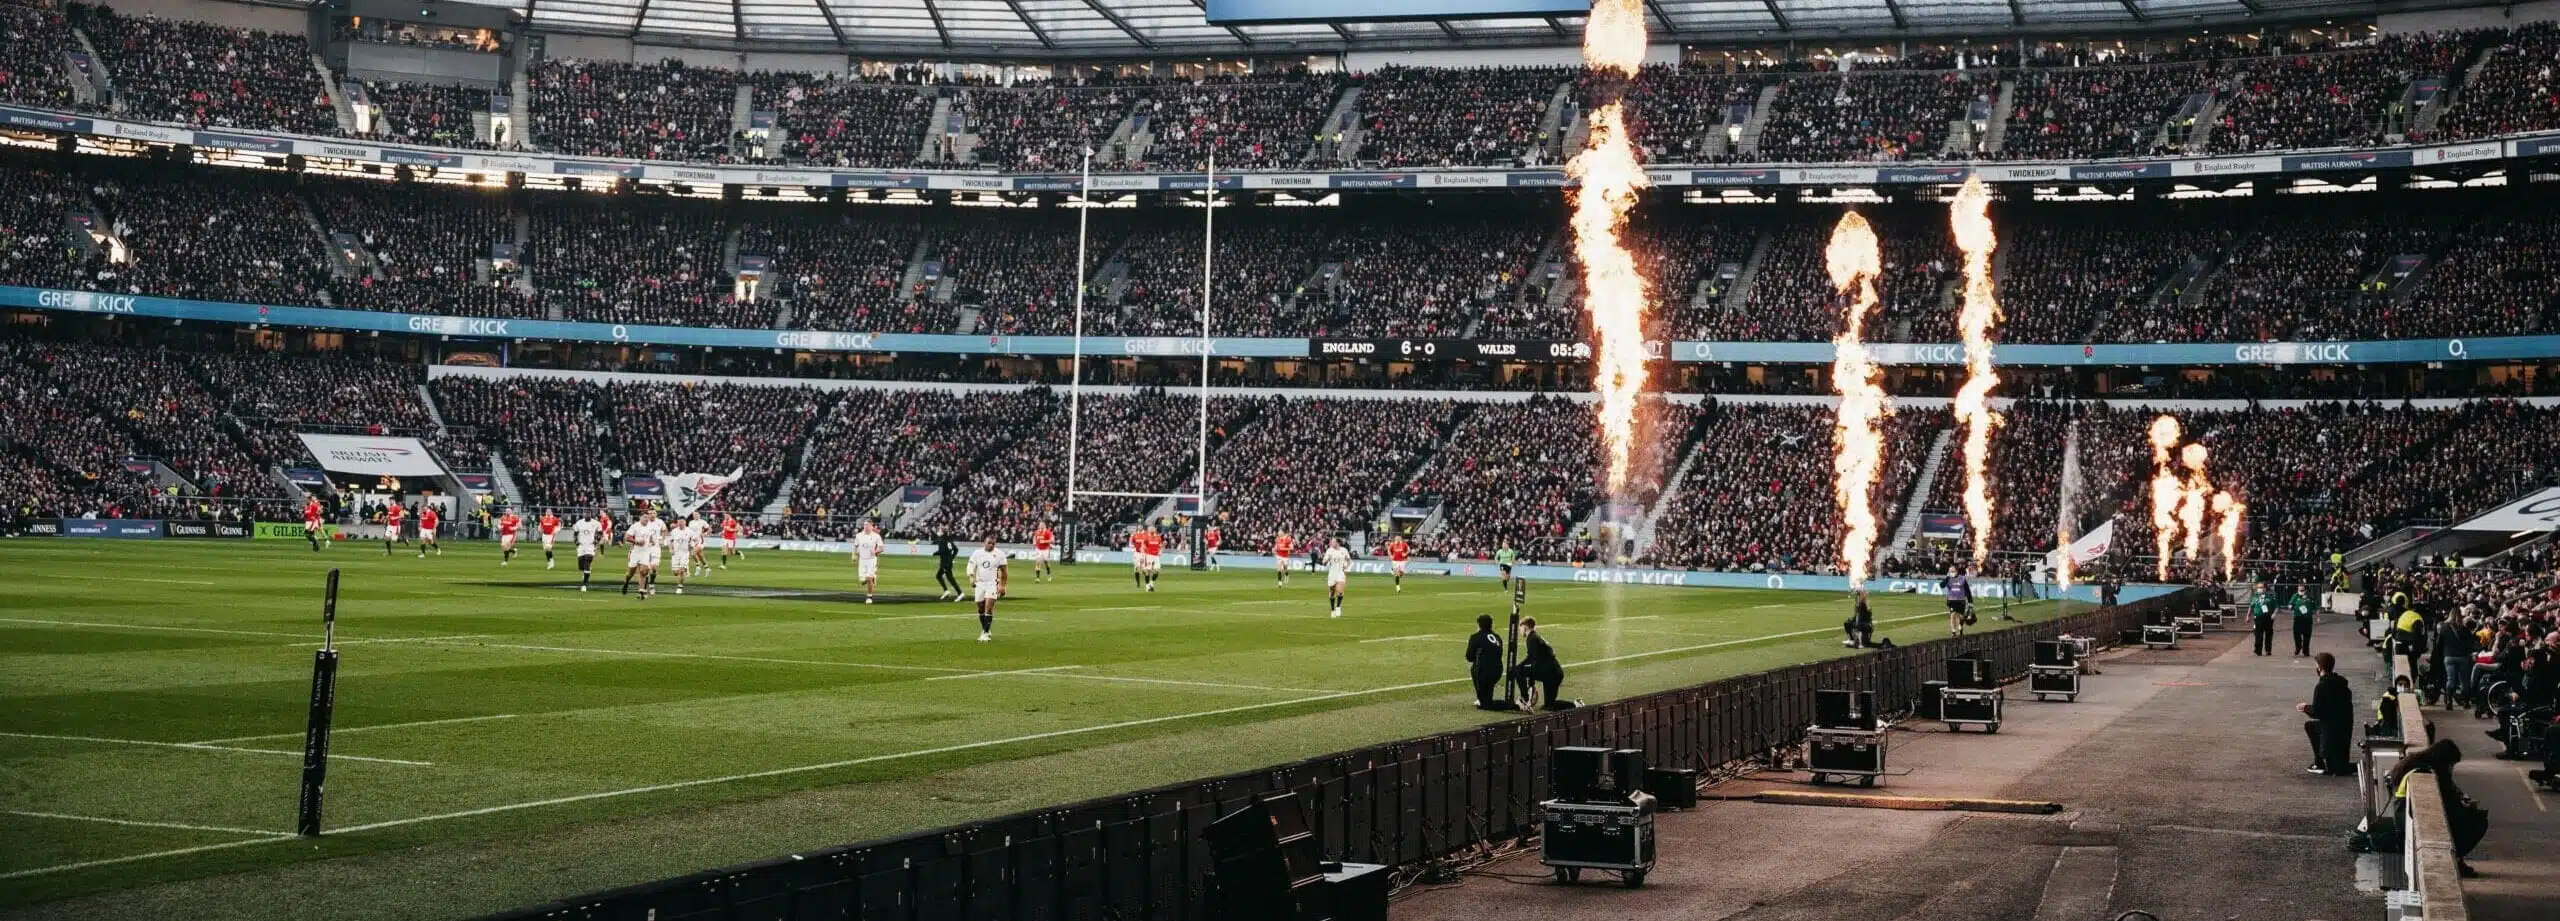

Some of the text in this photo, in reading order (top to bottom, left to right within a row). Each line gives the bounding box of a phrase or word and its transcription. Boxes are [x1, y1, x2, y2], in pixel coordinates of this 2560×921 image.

[10, 115, 63, 129] BRITISH AIRWAYS
[212, 139, 266, 151] BRITISH AIRWAYS
[323, 146, 367, 157] TWICKENHAM
[2447, 148, 2496, 159] England Rugby
[387, 155, 439, 167] BRITISH AIRWAYS
[2301, 159, 2363, 170] BRITISH AIRWAYS
[2204, 162, 2256, 173] England Rugby
[674, 170, 716, 180] TWICKENHAM
[2008, 168, 2057, 179] TWICKENHAM
[2077, 170, 2134, 181] BRITISH AIRWAYS
[848, 179, 899, 187] BRITISH AIRWAYS
[962, 179, 1003, 188] TWICKENHAM
[1170, 181, 1219, 189] BRITISH AIRWYS
[1270, 177, 1311, 186] TWICKENHAM
[1341, 180, 1392, 188] BRITISH AIRWAYS
[1443, 175, 1489, 185] England Rugby
[1698, 175, 1753, 185] BRITISH AIRWAYS
[38, 290, 136, 313] GRE KICK
[408, 316, 508, 335] GRE KICK
[776, 332, 873, 349] GRE KICK
[1124, 340, 1175, 354] GRE
[1322, 342, 1375, 353] ENGLAND
[1477, 344, 1516, 355] WALES
[1550, 342, 1591, 357] 05:2
[2235, 343, 2350, 362] GRE KICK
[1914, 345, 1957, 361] KICK
[332, 455, 392, 463] AIRWAYS
[176, 524, 206, 535] GUINNESS
[221, 525, 242, 536] GUINNE
[273, 525, 306, 537] GILBE
[1642, 571, 1687, 586] KICK
[1889, 581, 1944, 595] GREA
